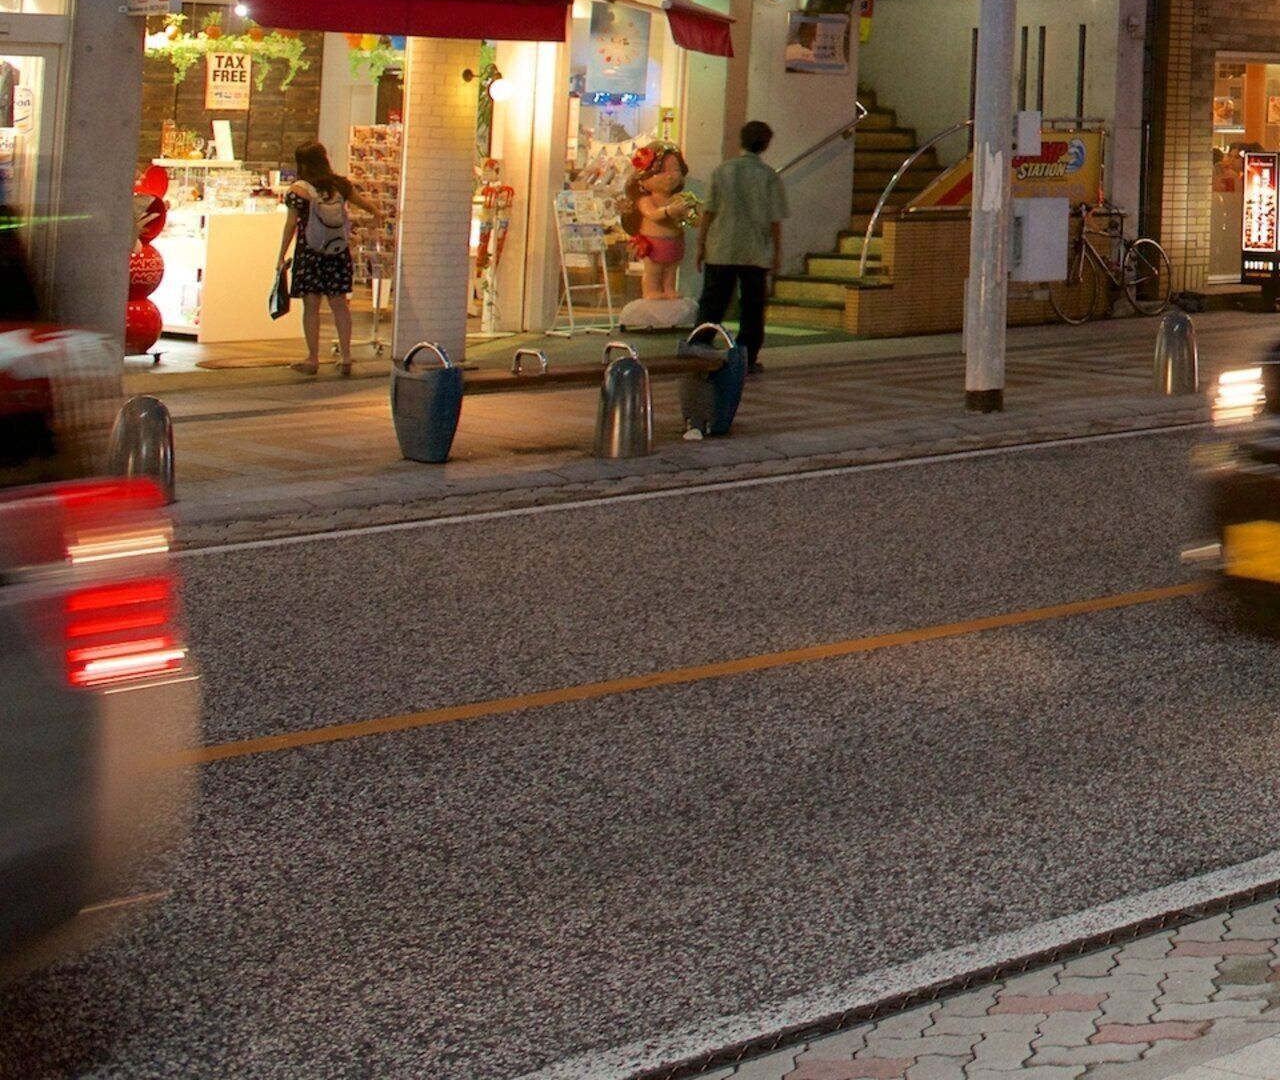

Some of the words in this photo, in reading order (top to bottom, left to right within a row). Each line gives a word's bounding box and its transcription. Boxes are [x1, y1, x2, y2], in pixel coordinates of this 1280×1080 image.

[215, 55, 245, 69] TAX
[212, 70, 248, 83] FREE
[1017, 163, 1067, 180] STATION
